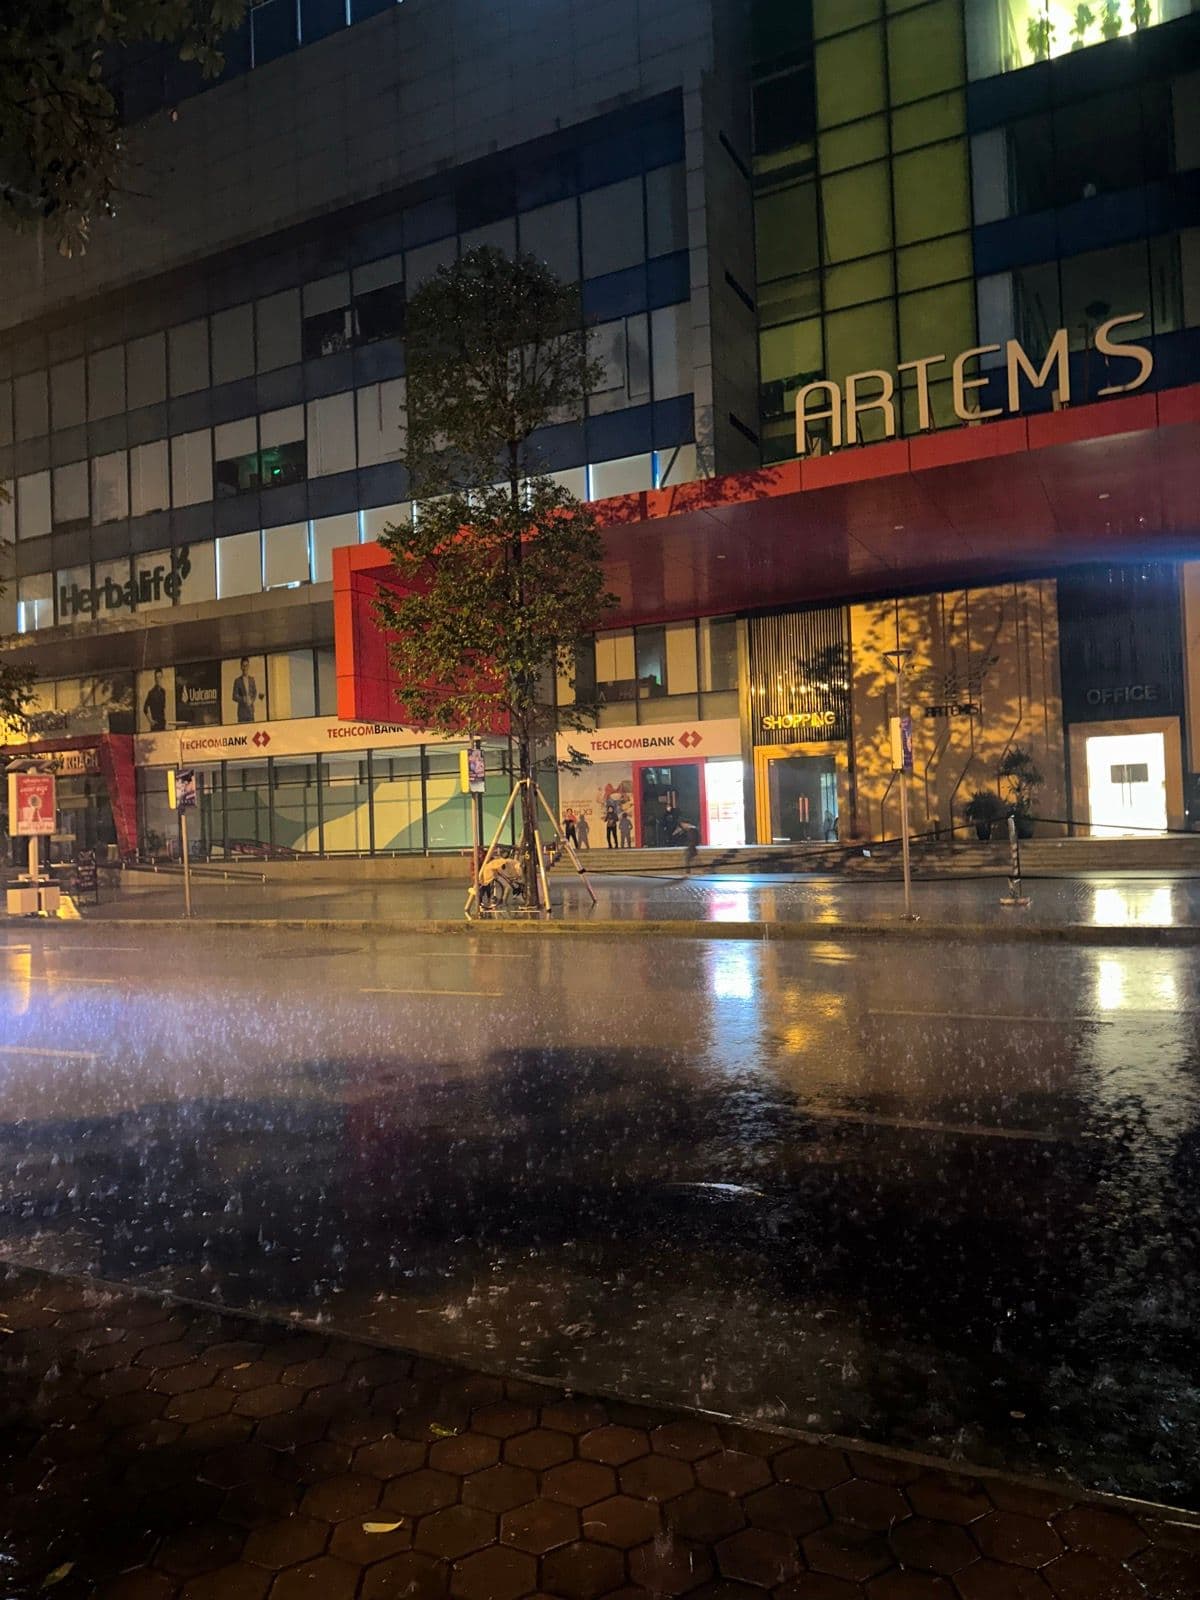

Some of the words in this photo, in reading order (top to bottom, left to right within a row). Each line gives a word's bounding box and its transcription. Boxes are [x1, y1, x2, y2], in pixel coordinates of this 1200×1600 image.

[60, 565, 183, 616] Herbalife
[1086, 684, 1160, 705] OFFICE
[762, 710, 836, 730] SHOPPING
[182, 736, 248, 750] TECHCOMBANK
[591, 736, 675, 751] TECHCOMBANK
